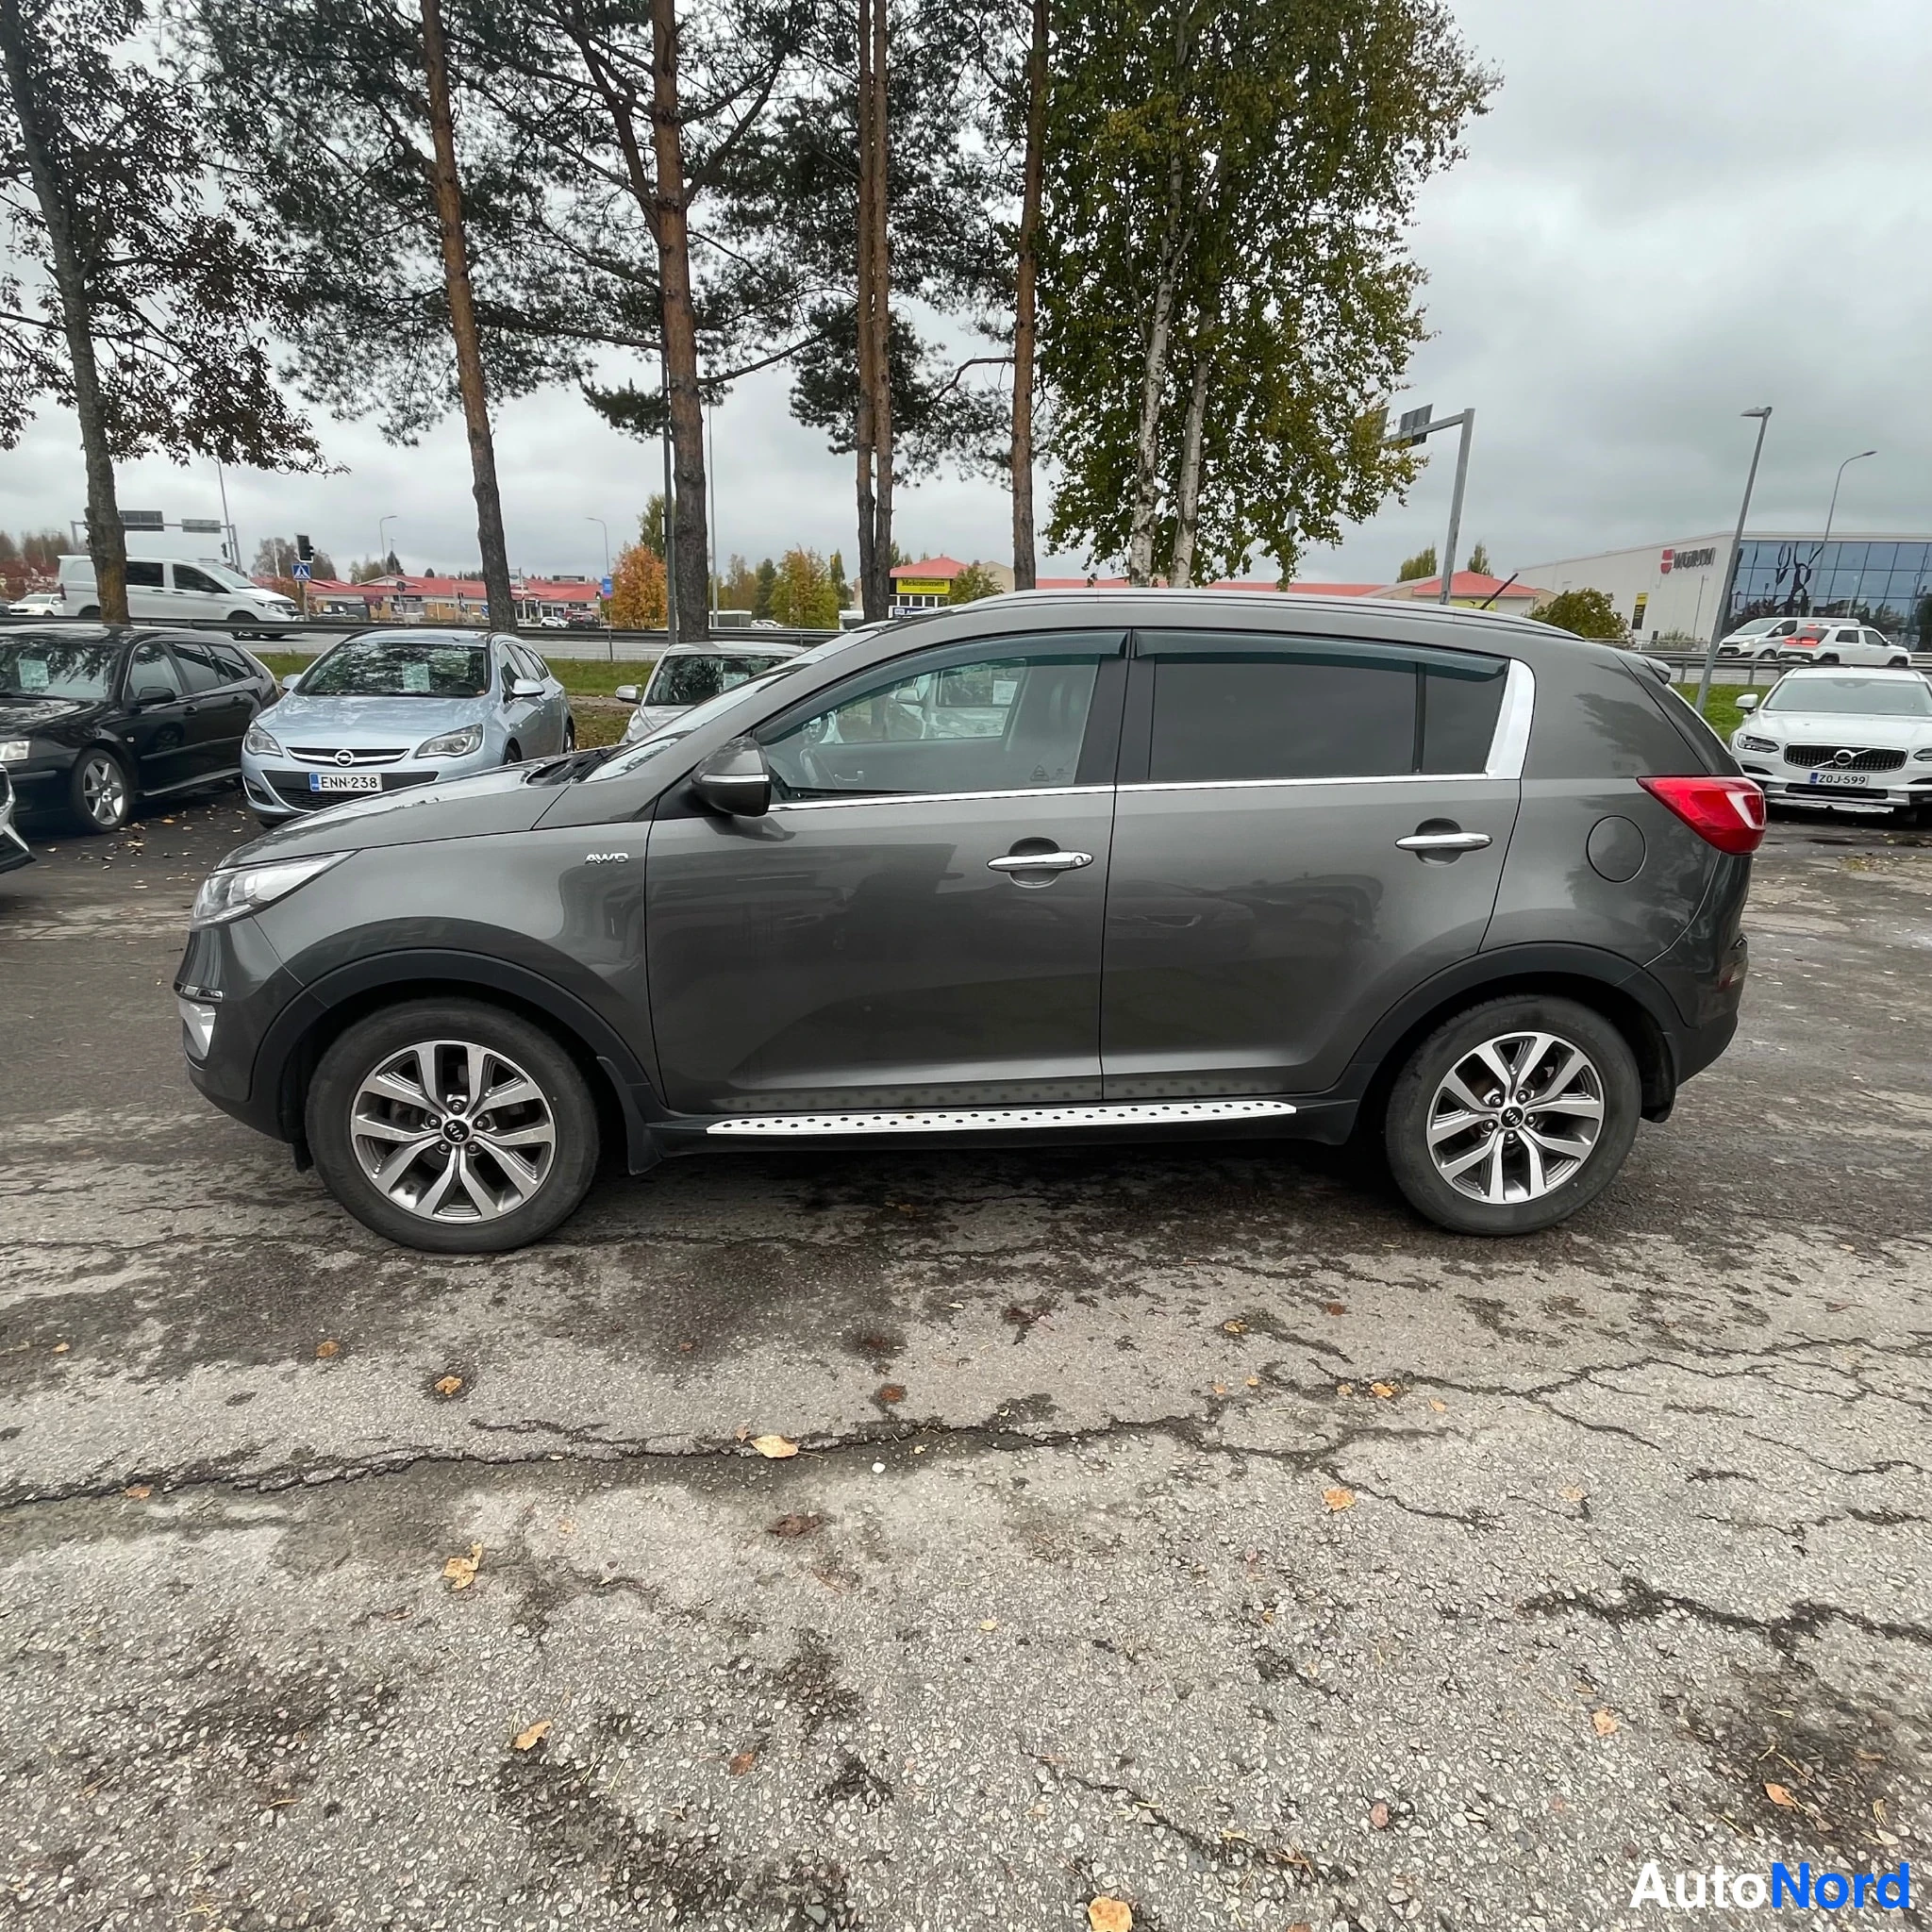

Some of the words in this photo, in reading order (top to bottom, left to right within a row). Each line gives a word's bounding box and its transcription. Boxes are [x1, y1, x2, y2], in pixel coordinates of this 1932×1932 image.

[321, 776, 377, 789] ENN-238
[1818, 774, 1866, 785] ZOJ-599
[585, 852, 629, 865] AWD
[1506, 1108, 1521, 1125] KIA
[447, 1123, 464, 1141] KIA
